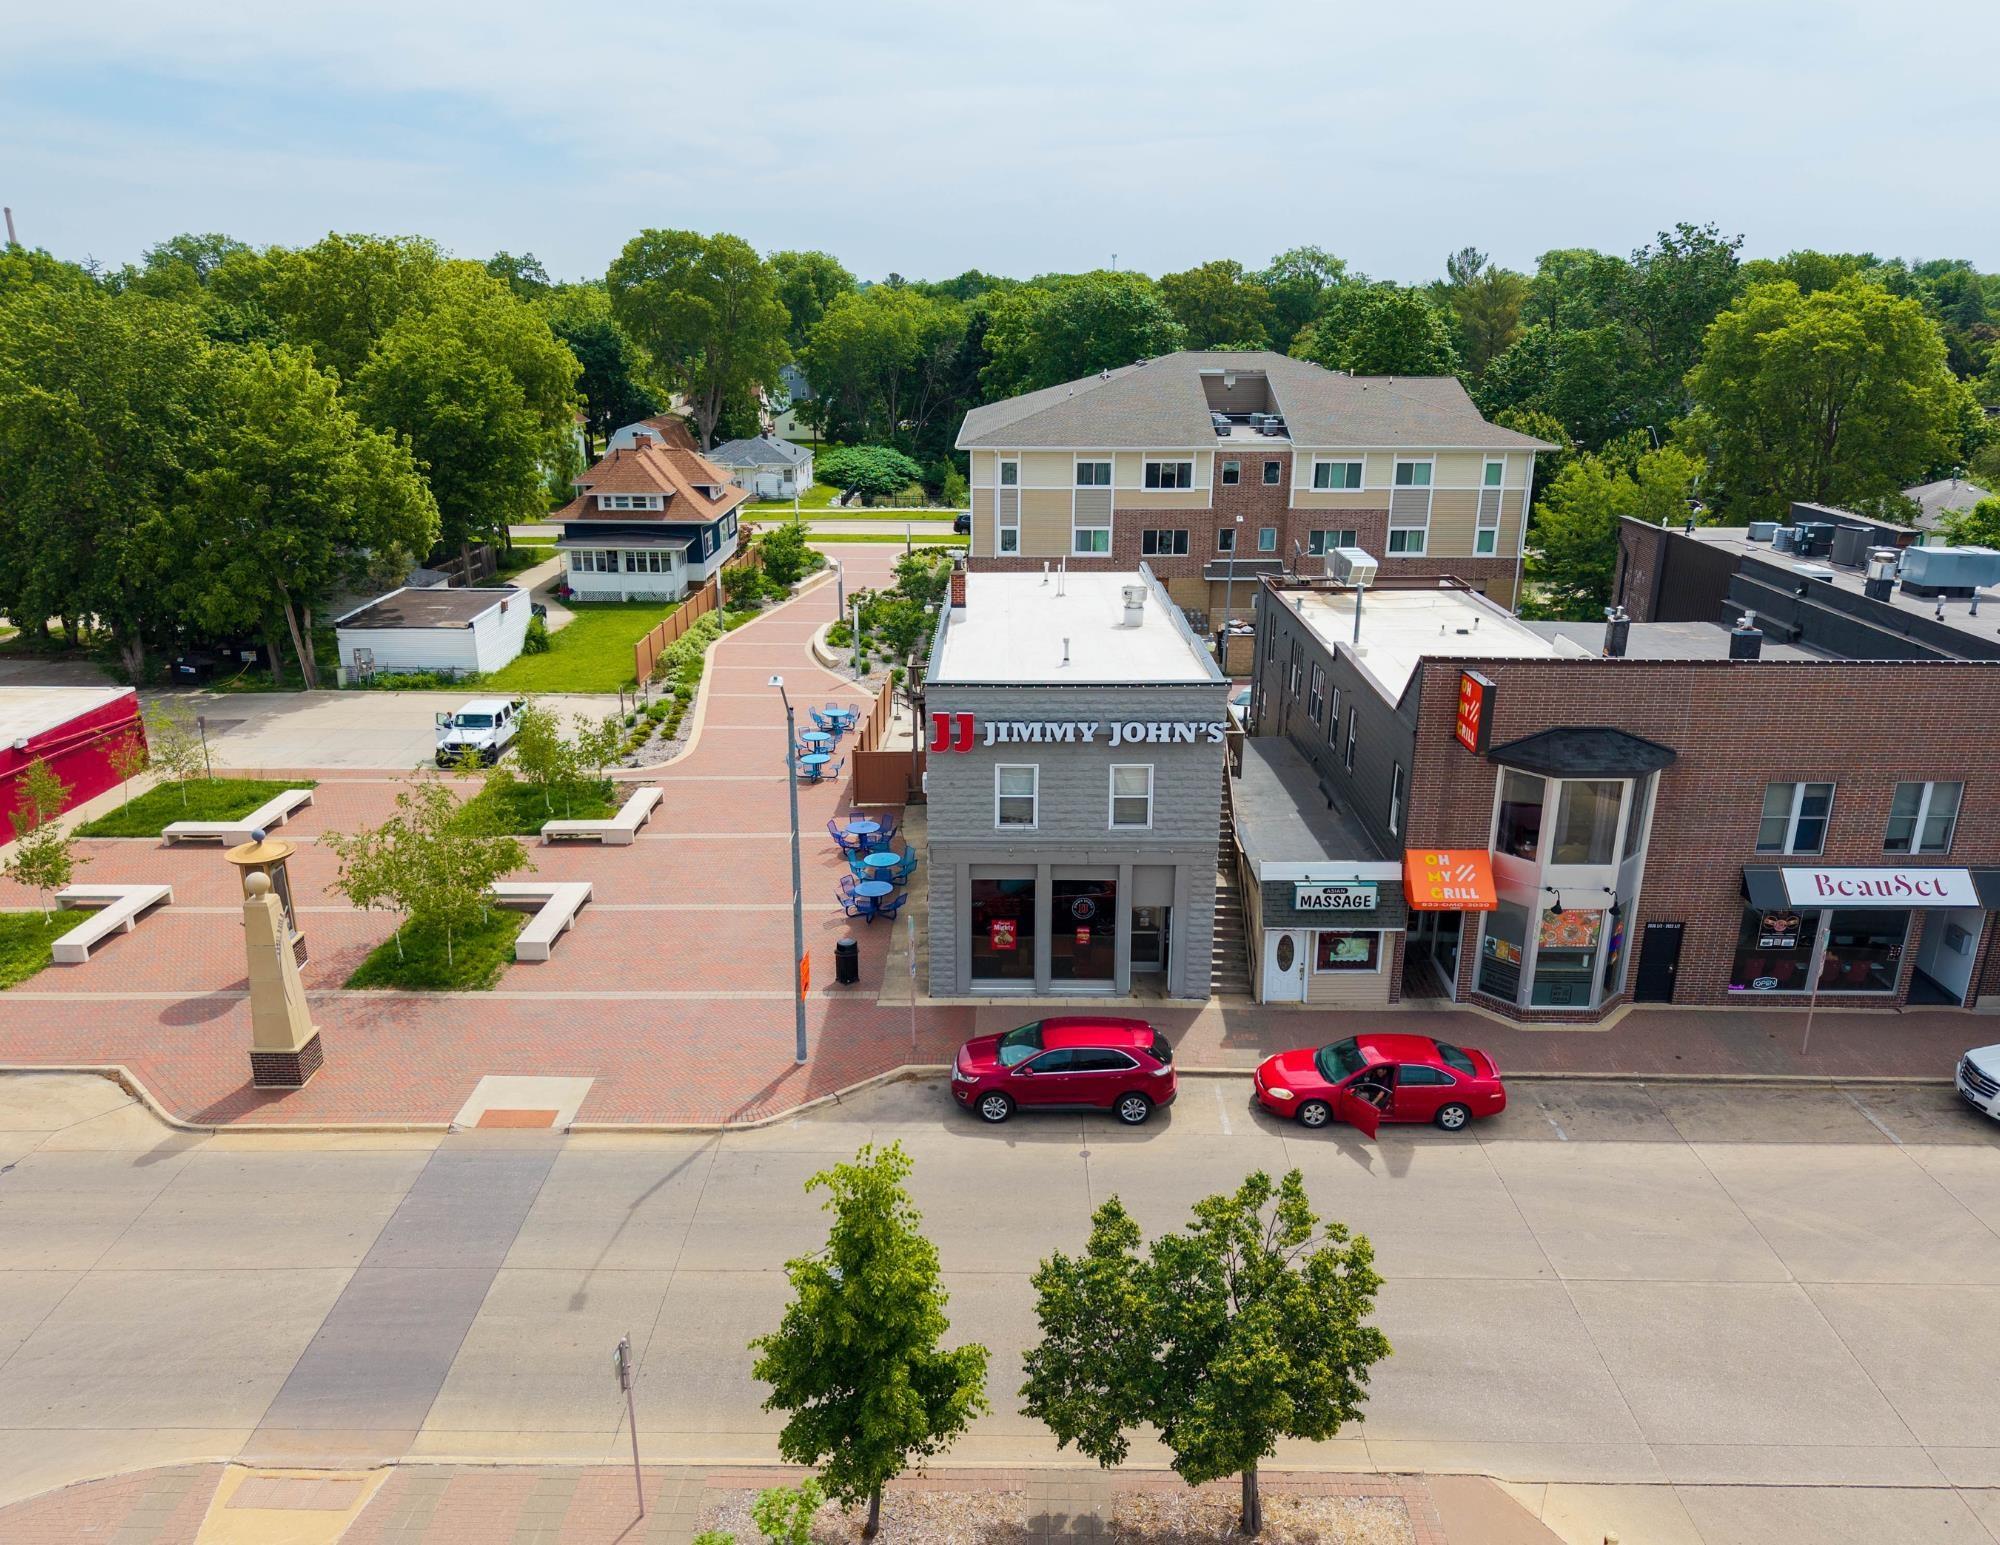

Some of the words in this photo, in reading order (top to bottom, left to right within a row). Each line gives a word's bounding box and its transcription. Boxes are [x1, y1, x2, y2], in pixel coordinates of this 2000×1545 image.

[1461, 679, 1472, 697] OH
[930, 711, 975, 753] JJ
[983, 721, 1099, 747] JIMMY
[1108, 721, 1226, 747] JOHN'S
[1457, 721, 1475, 747] GRILL
[1425, 854, 1450, 866] OH
[1427, 871, 1452, 882] MY
[1430, 887, 1480, 899] GRILL
[1300, 895, 1371, 908] MASSAGE
